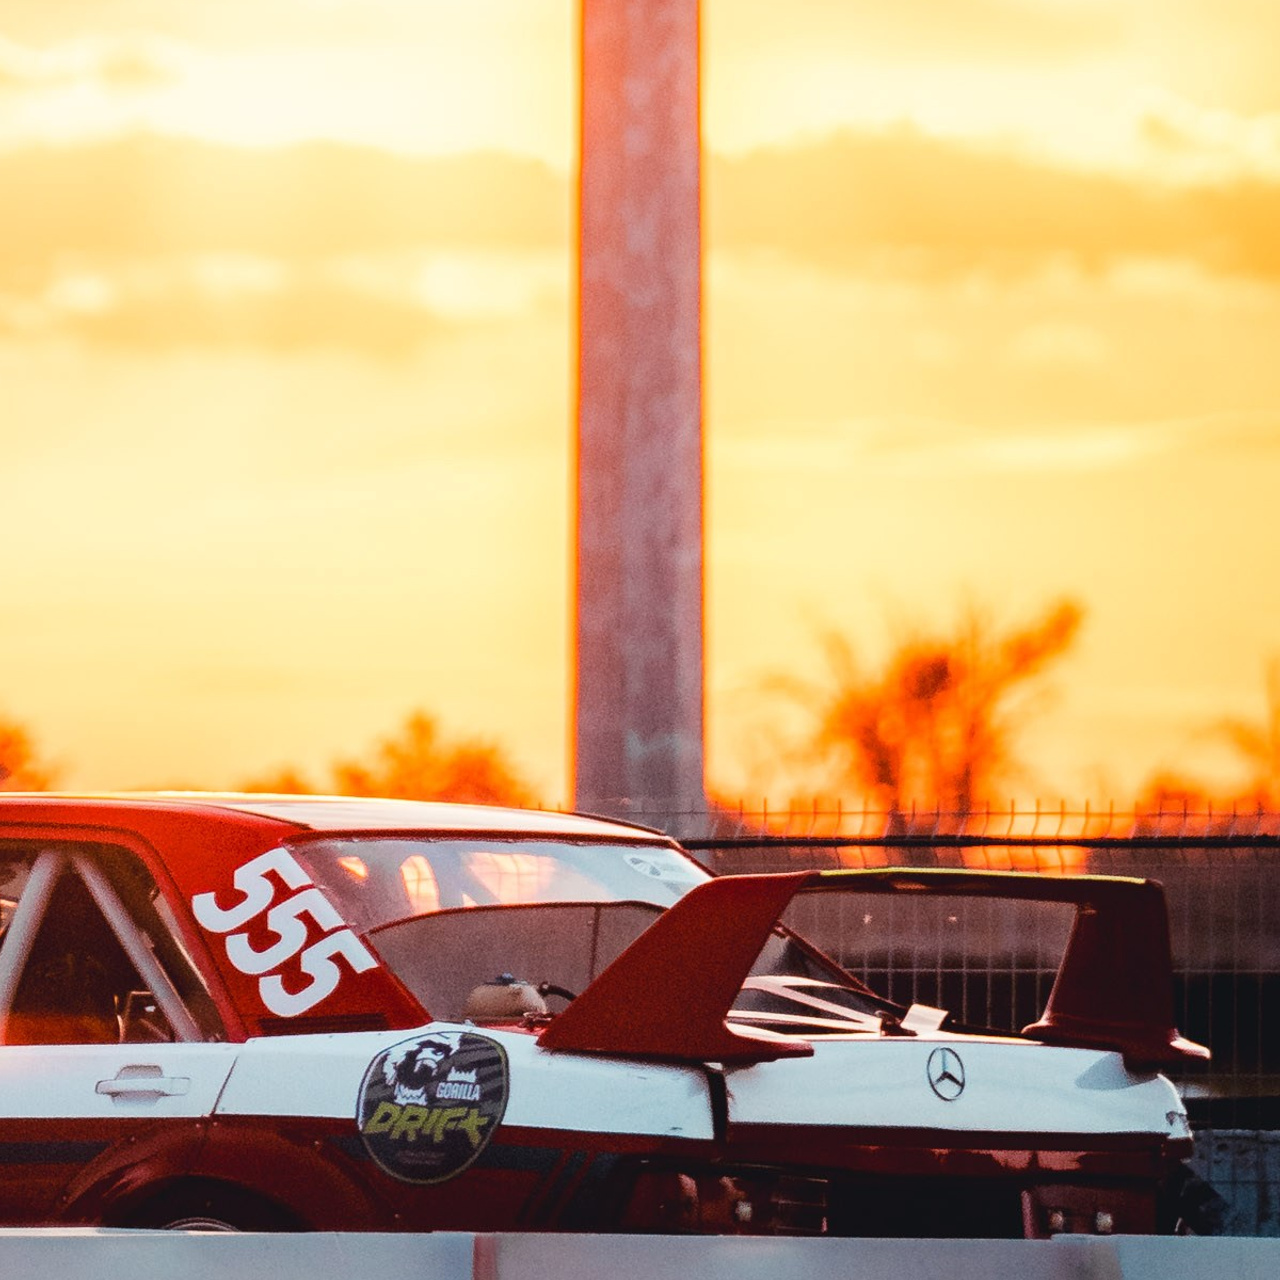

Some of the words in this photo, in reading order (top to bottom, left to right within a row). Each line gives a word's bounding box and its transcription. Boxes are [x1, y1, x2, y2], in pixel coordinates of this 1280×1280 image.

[192, 847, 379, 1018] 555
[436, 1081, 481, 1102] GORILLA
[362, 1101, 489, 1149] DRIFT
